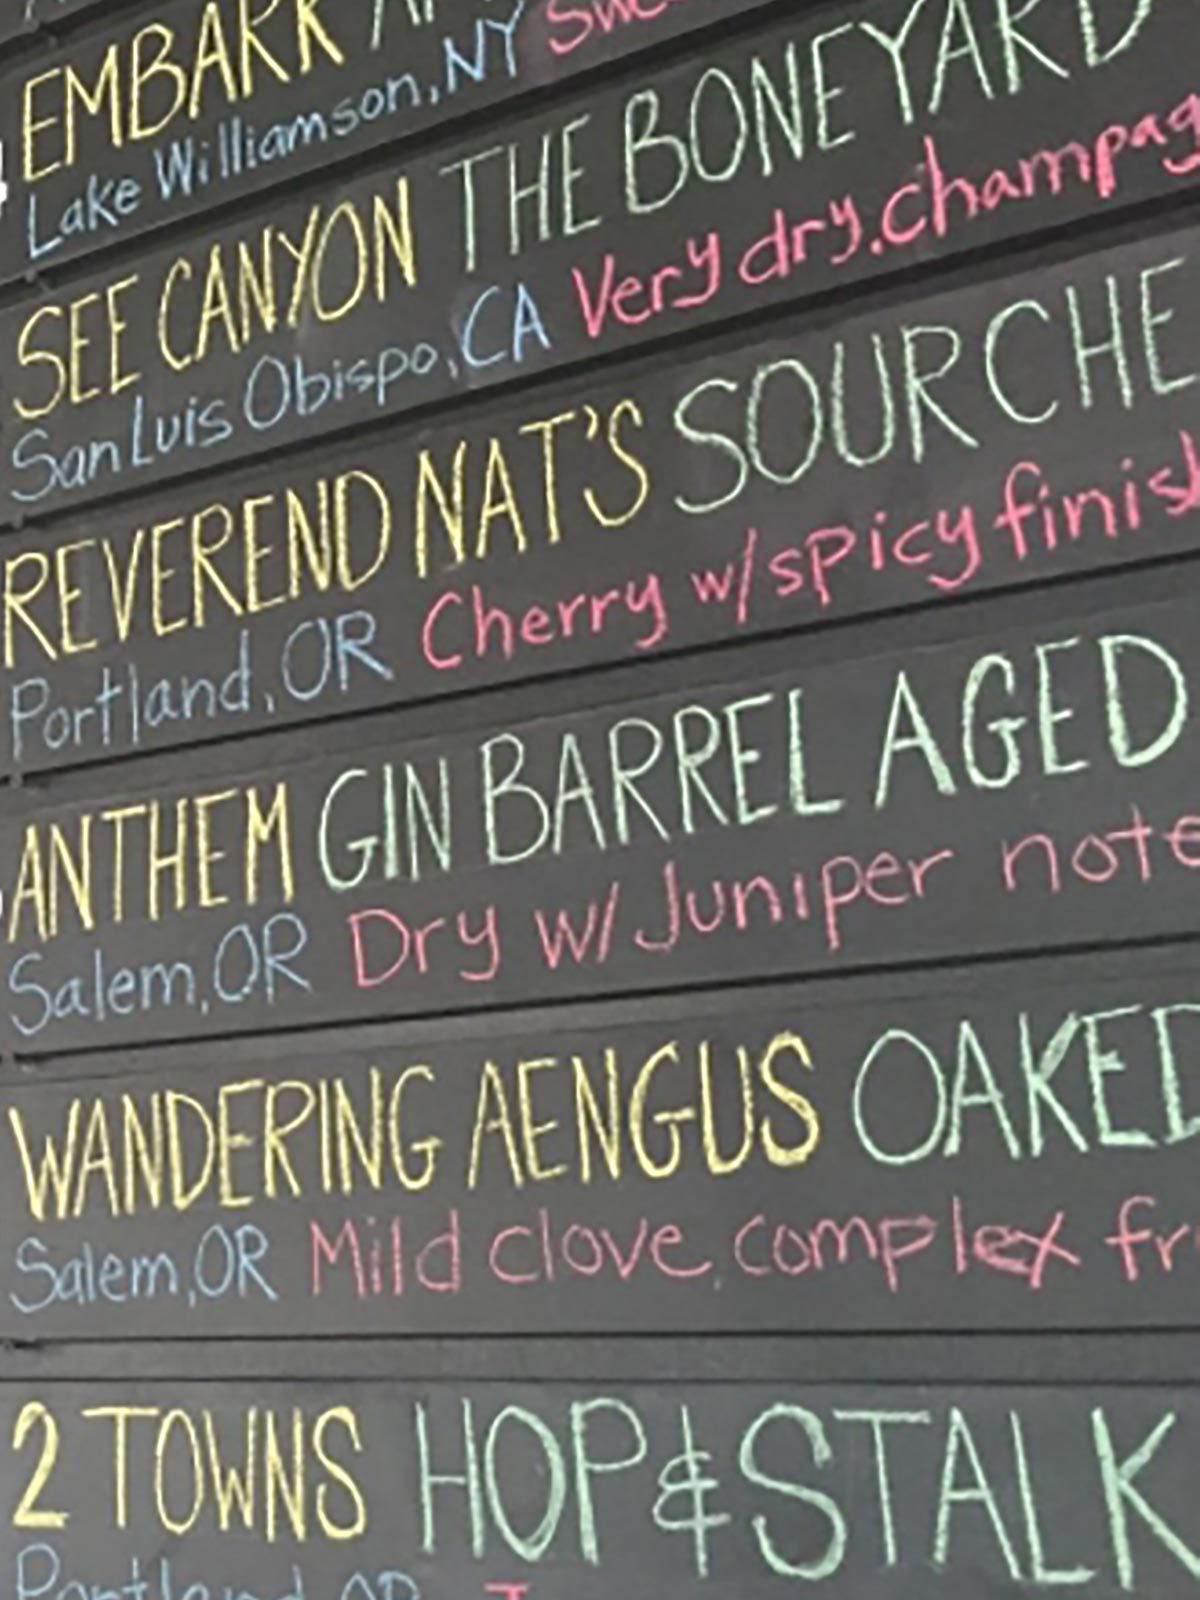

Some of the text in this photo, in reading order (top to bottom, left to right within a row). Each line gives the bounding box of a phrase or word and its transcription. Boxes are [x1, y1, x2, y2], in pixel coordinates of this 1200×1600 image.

[22, 0, 345, 181] EMBARK
[10, 0, 1153, 418] SEE CANYON THE BONEYARD
[27, 190, 142, 260] Lake
[10, 430, 121, 502] San
[131, 394, 232, 466] Luis
[572, 231, 720, 338] Very
[1, 468, 392, 669] REVEREND
[416, 399, 649, 580] NAT'S
[673, 326, 980, 513] SOUR
[421, 582, 668, 670] Cherry
[6, 633, 1188, 945] ANTHEM GIN BARREL AGED
[349, 904, 502, 989] Dry
[8, 1064, 444, 1222] WANDERING
[467, 1030, 820, 1190] AENGUS
[308, 1206, 461, 1298] Mild
[733, 1193, 1081, 1294] complex
[11, 1399, 70, 1529] 2
[81, 1404, 368, 1544] TOWNS
